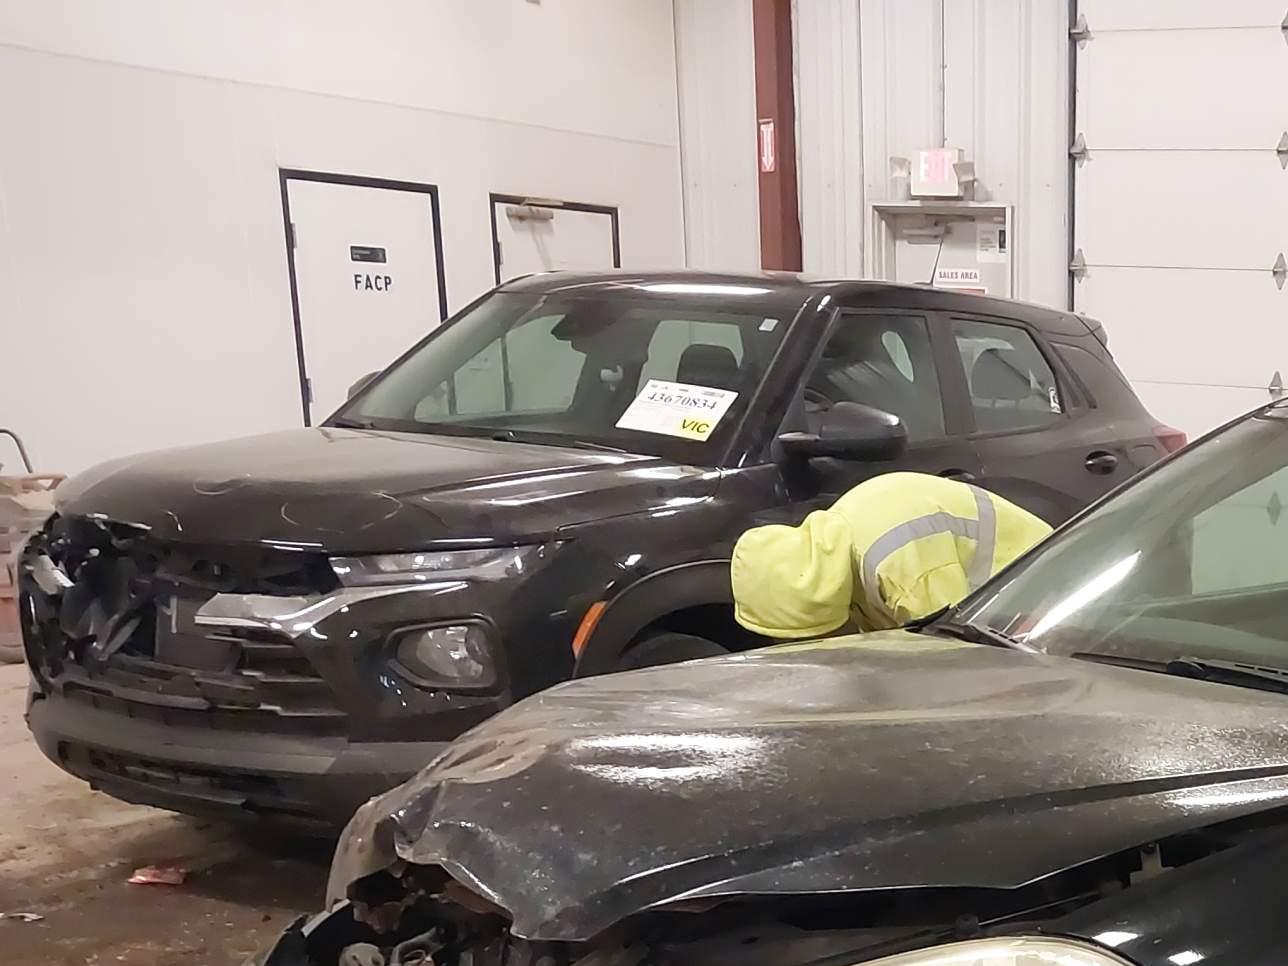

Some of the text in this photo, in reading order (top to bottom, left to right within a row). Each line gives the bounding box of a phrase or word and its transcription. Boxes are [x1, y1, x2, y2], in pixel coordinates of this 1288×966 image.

[353, 274, 392, 291] FACP
[939, 271, 978, 280] SALES AREA
[648, 392, 717, 410] 43670834
[681, 418, 710, 434] VIC
